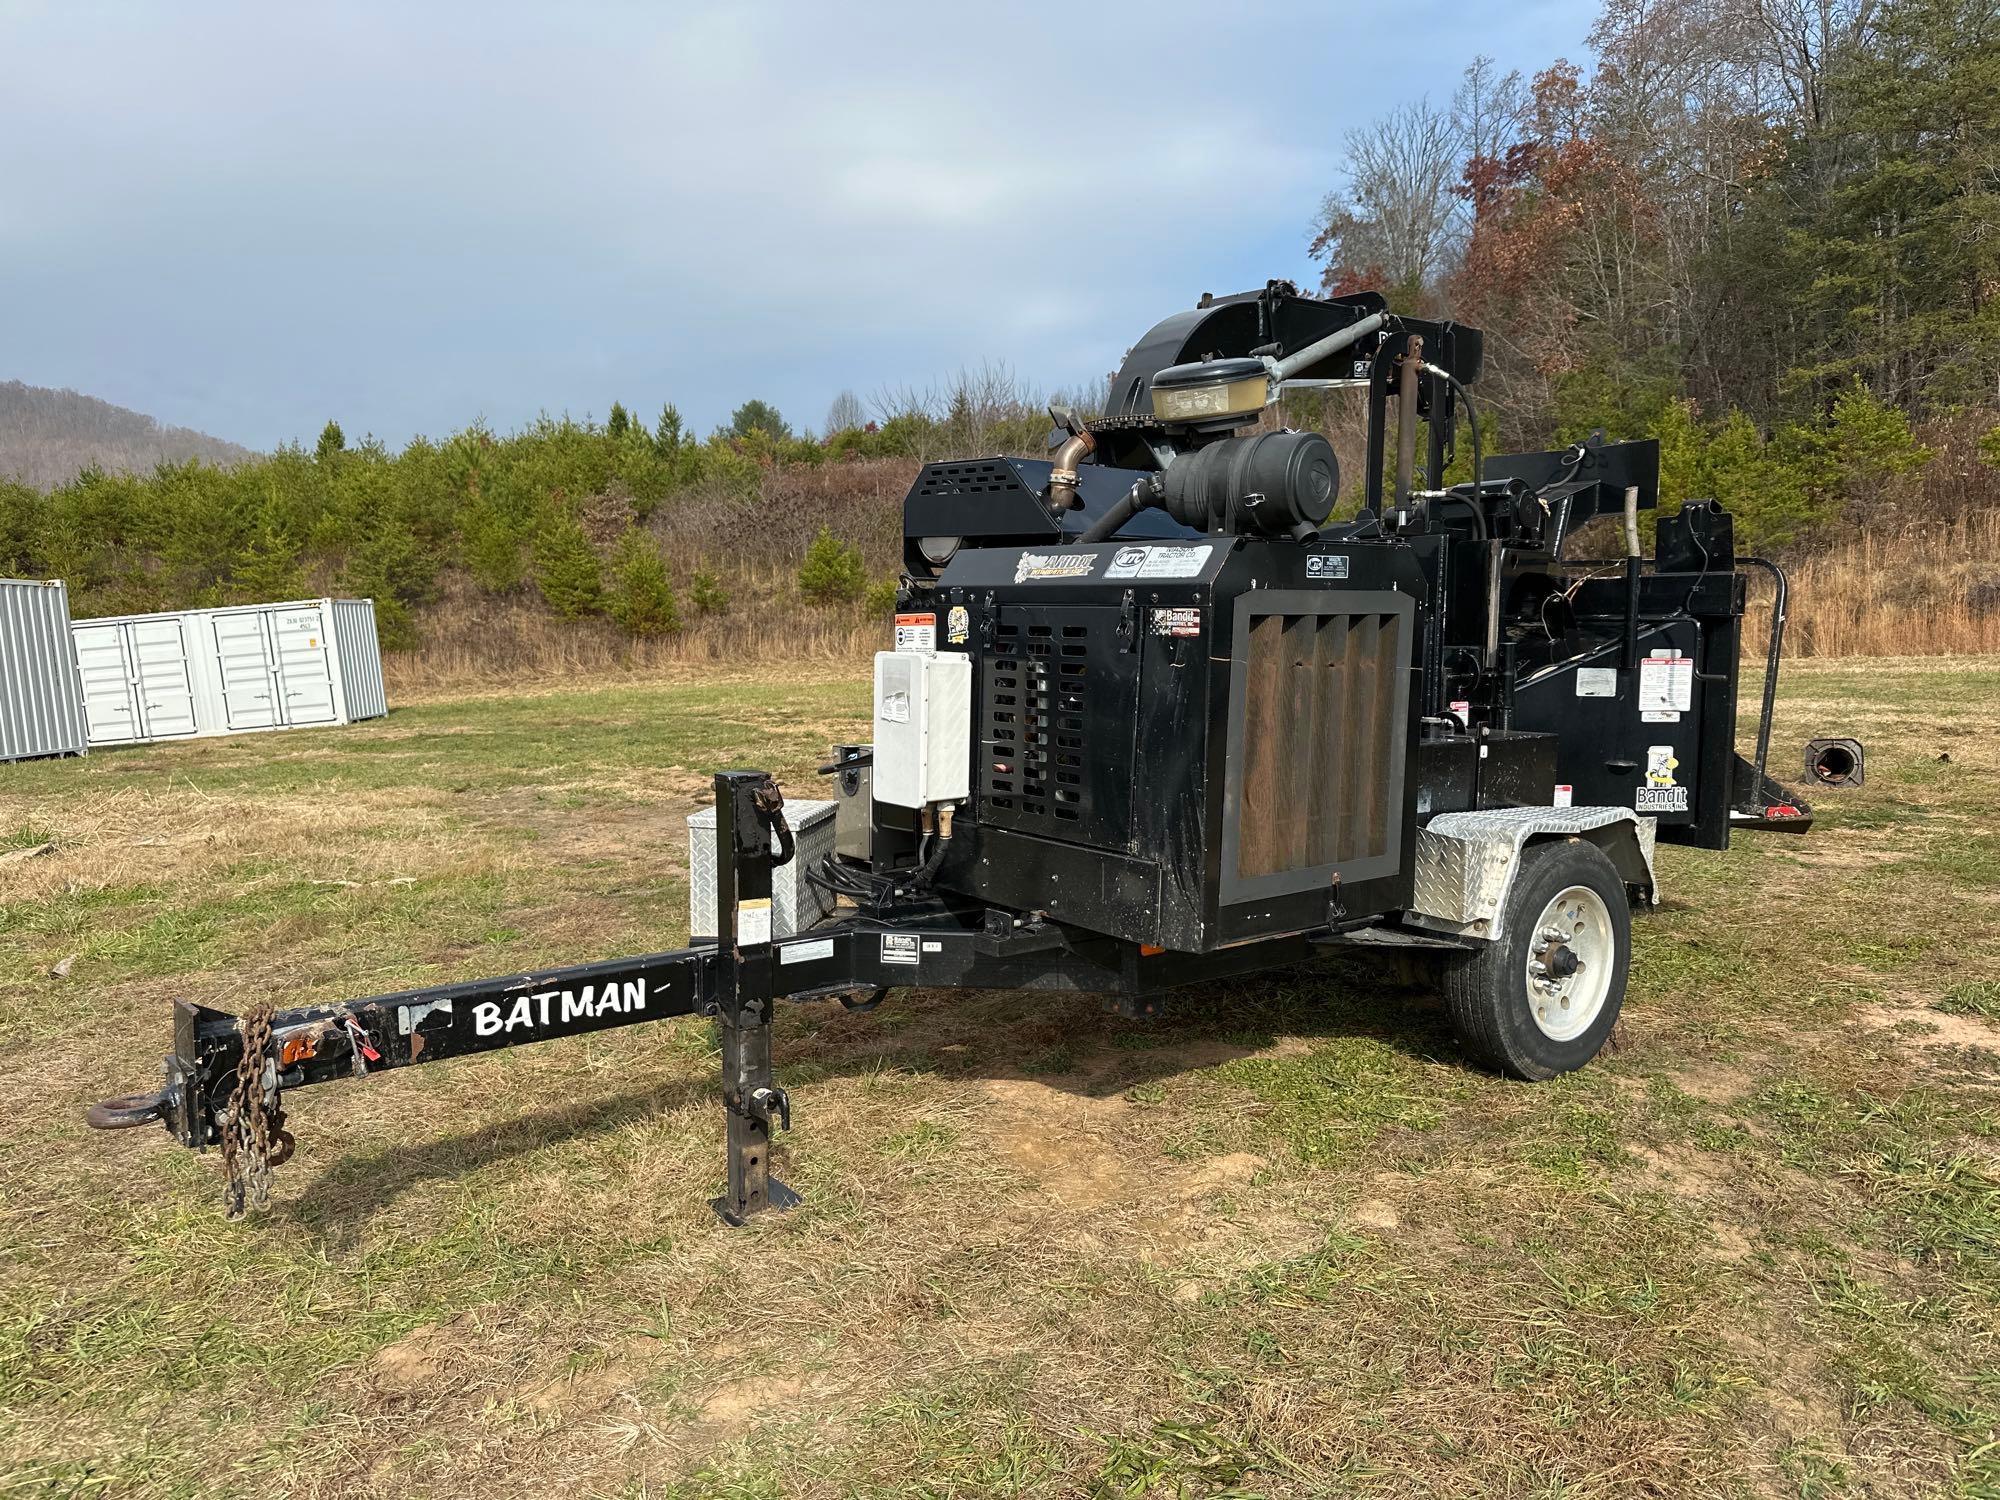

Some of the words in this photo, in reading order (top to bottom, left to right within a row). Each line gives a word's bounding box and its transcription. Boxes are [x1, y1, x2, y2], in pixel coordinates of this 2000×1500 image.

[1166, 609, 1194, 622] Bandit
[1637, 787, 1688, 804] Bandit
[1636, 803, 1674, 812] INDUSTRIES,
[471, 978, 646, 1036] BATMAN
